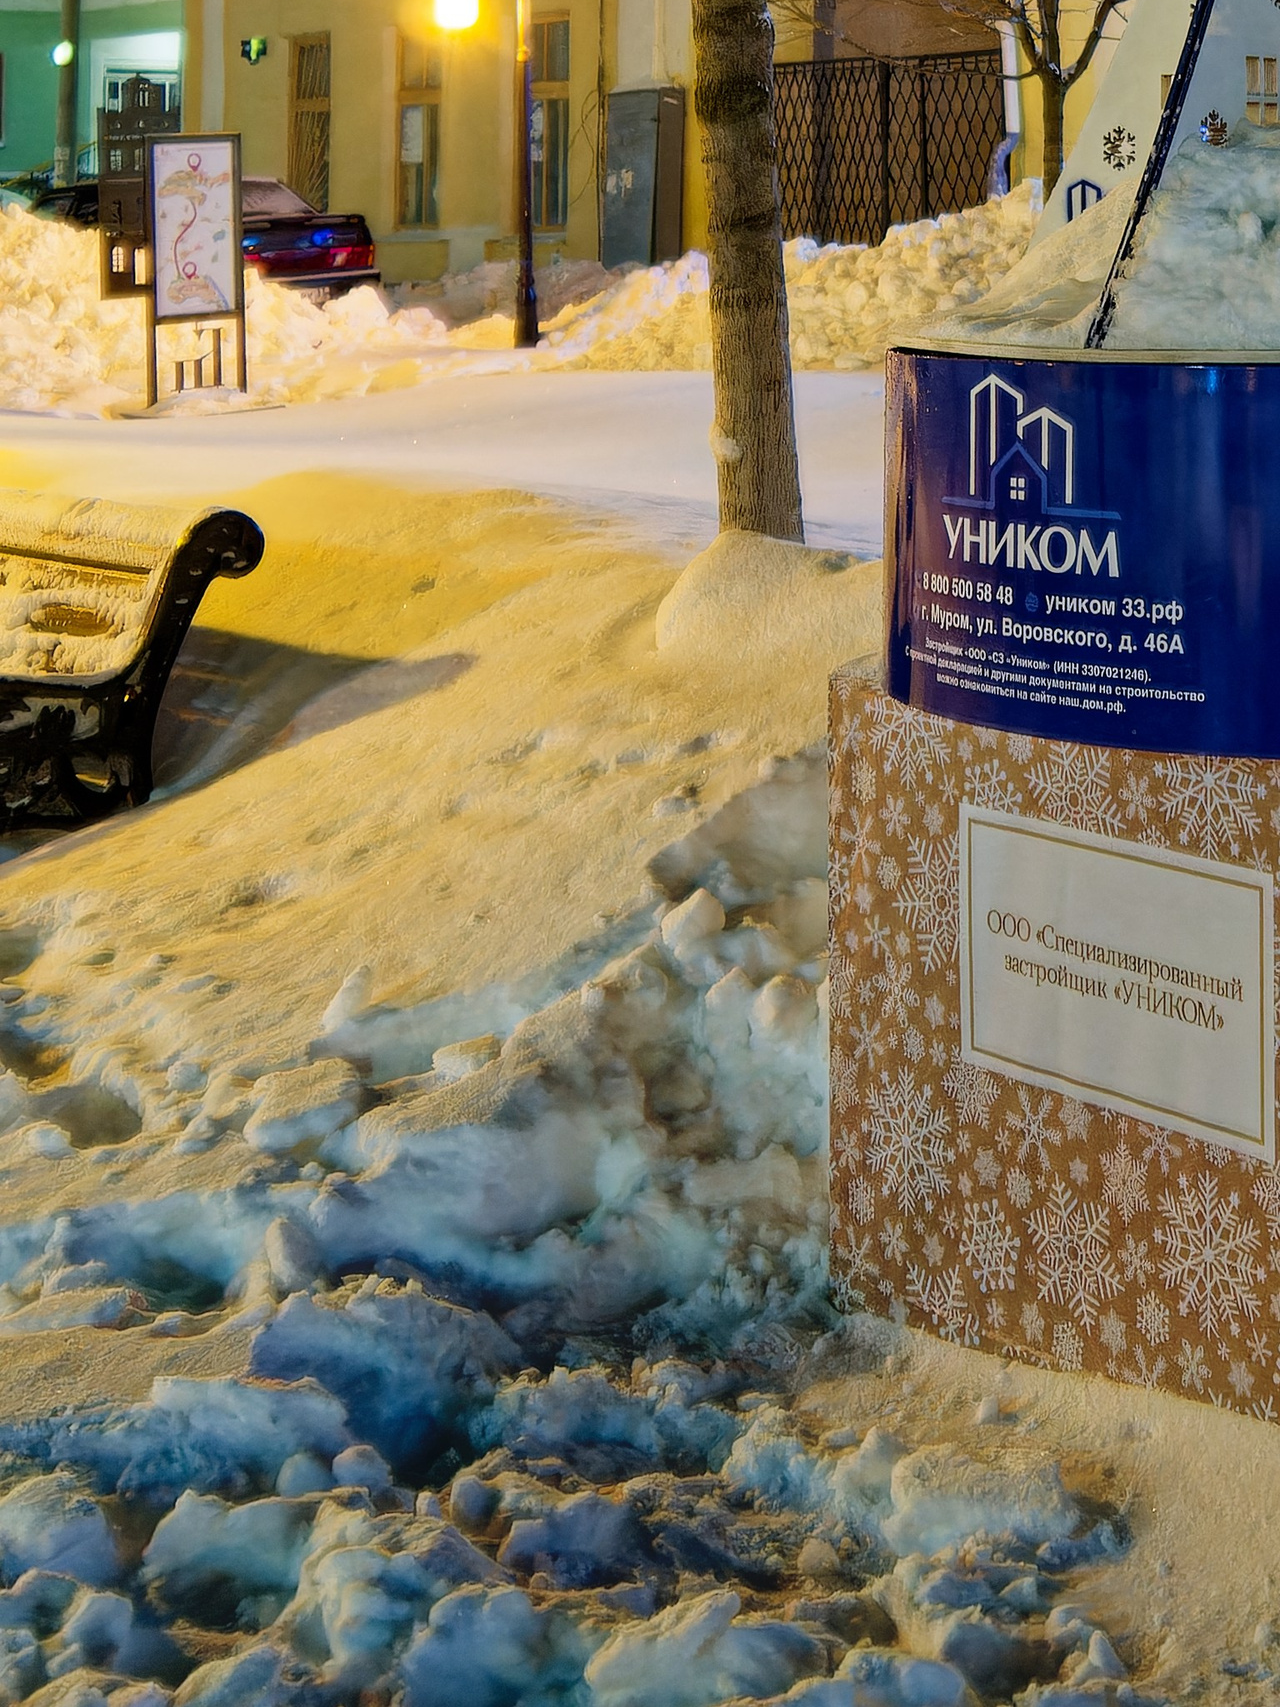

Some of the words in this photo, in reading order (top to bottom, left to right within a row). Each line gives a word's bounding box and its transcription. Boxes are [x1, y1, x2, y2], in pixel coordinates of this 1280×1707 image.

[942, 514, 1120, 578] УНИКОМ
[922, 571, 929, 590] 8
[930, 573, 949, 595] 800
[951, 577, 973, 600] 500
[976, 582, 992, 602] 58
[995, 585, 1013, 606] 48
[1045, 594, 1115, 615] уником
[1121, 597, 1184, 625] 33.рф
[921, 604, 929, 621] г.
[931, 603, 973, 634] Муром,
[976, 617, 998, 637] ул.
[1002, 616, 1113, 653] Воровского,
[1118, 633, 1137, 654] д.
[1144, 632, 1185, 654] 46А
[1053, 660, 1079, 675] (ИНН
[984, 668, 990, 678] и
[991, 669, 1027, 684] другими
[1028, 675, 1097, 694] документами
[1099, 684, 1112, 695] на
[1114, 685, 1206, 703] строительство
[1016, 689, 1028, 701] на
[1029, 691, 1057, 705] сайте
[1058, 696, 1127, 715] наш.дом.рф.
[987, 909, 1031, 942] ООО
[1036, 924, 1243, 1002] «Специализированный
[1004, 954, 1107, 1000] застройщик
[1114, 979, 1224, 1031] «УНИКОМ»
